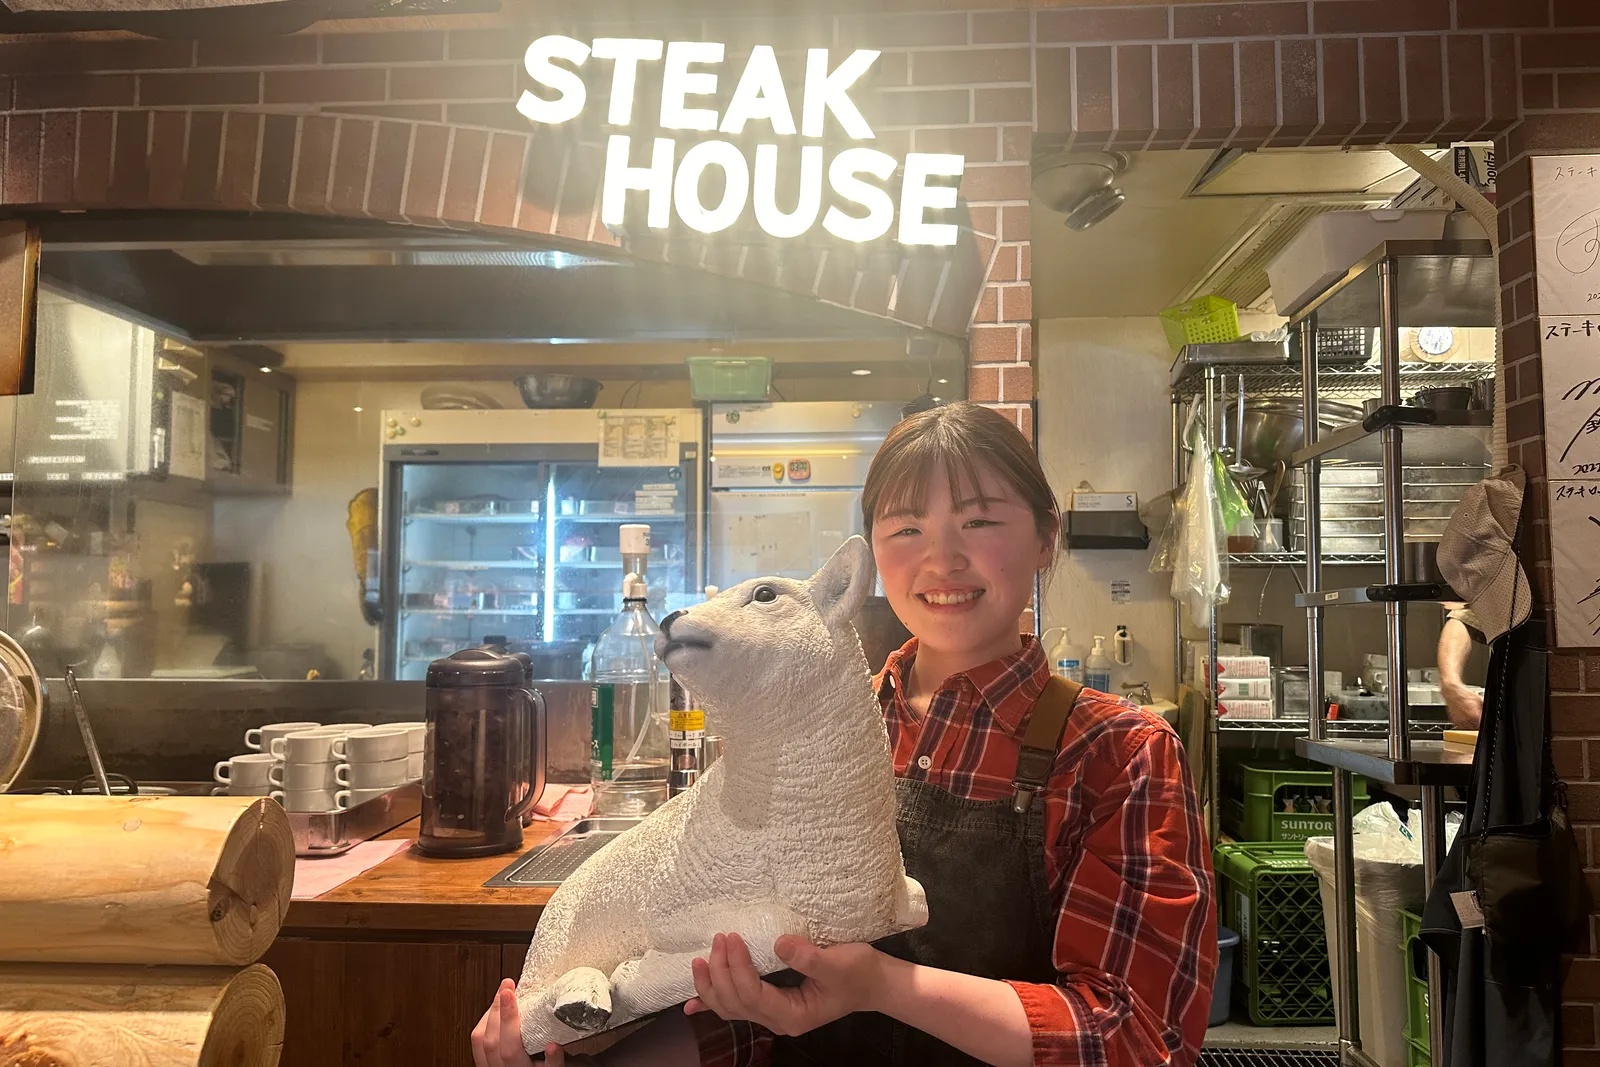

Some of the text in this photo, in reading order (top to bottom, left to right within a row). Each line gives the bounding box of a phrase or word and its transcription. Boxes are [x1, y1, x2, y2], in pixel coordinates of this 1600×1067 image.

[515, 34, 882, 140] STEAK
[601, 134, 966, 246] HOUSE
[1281, 820, 1334, 830] SUNTOR
